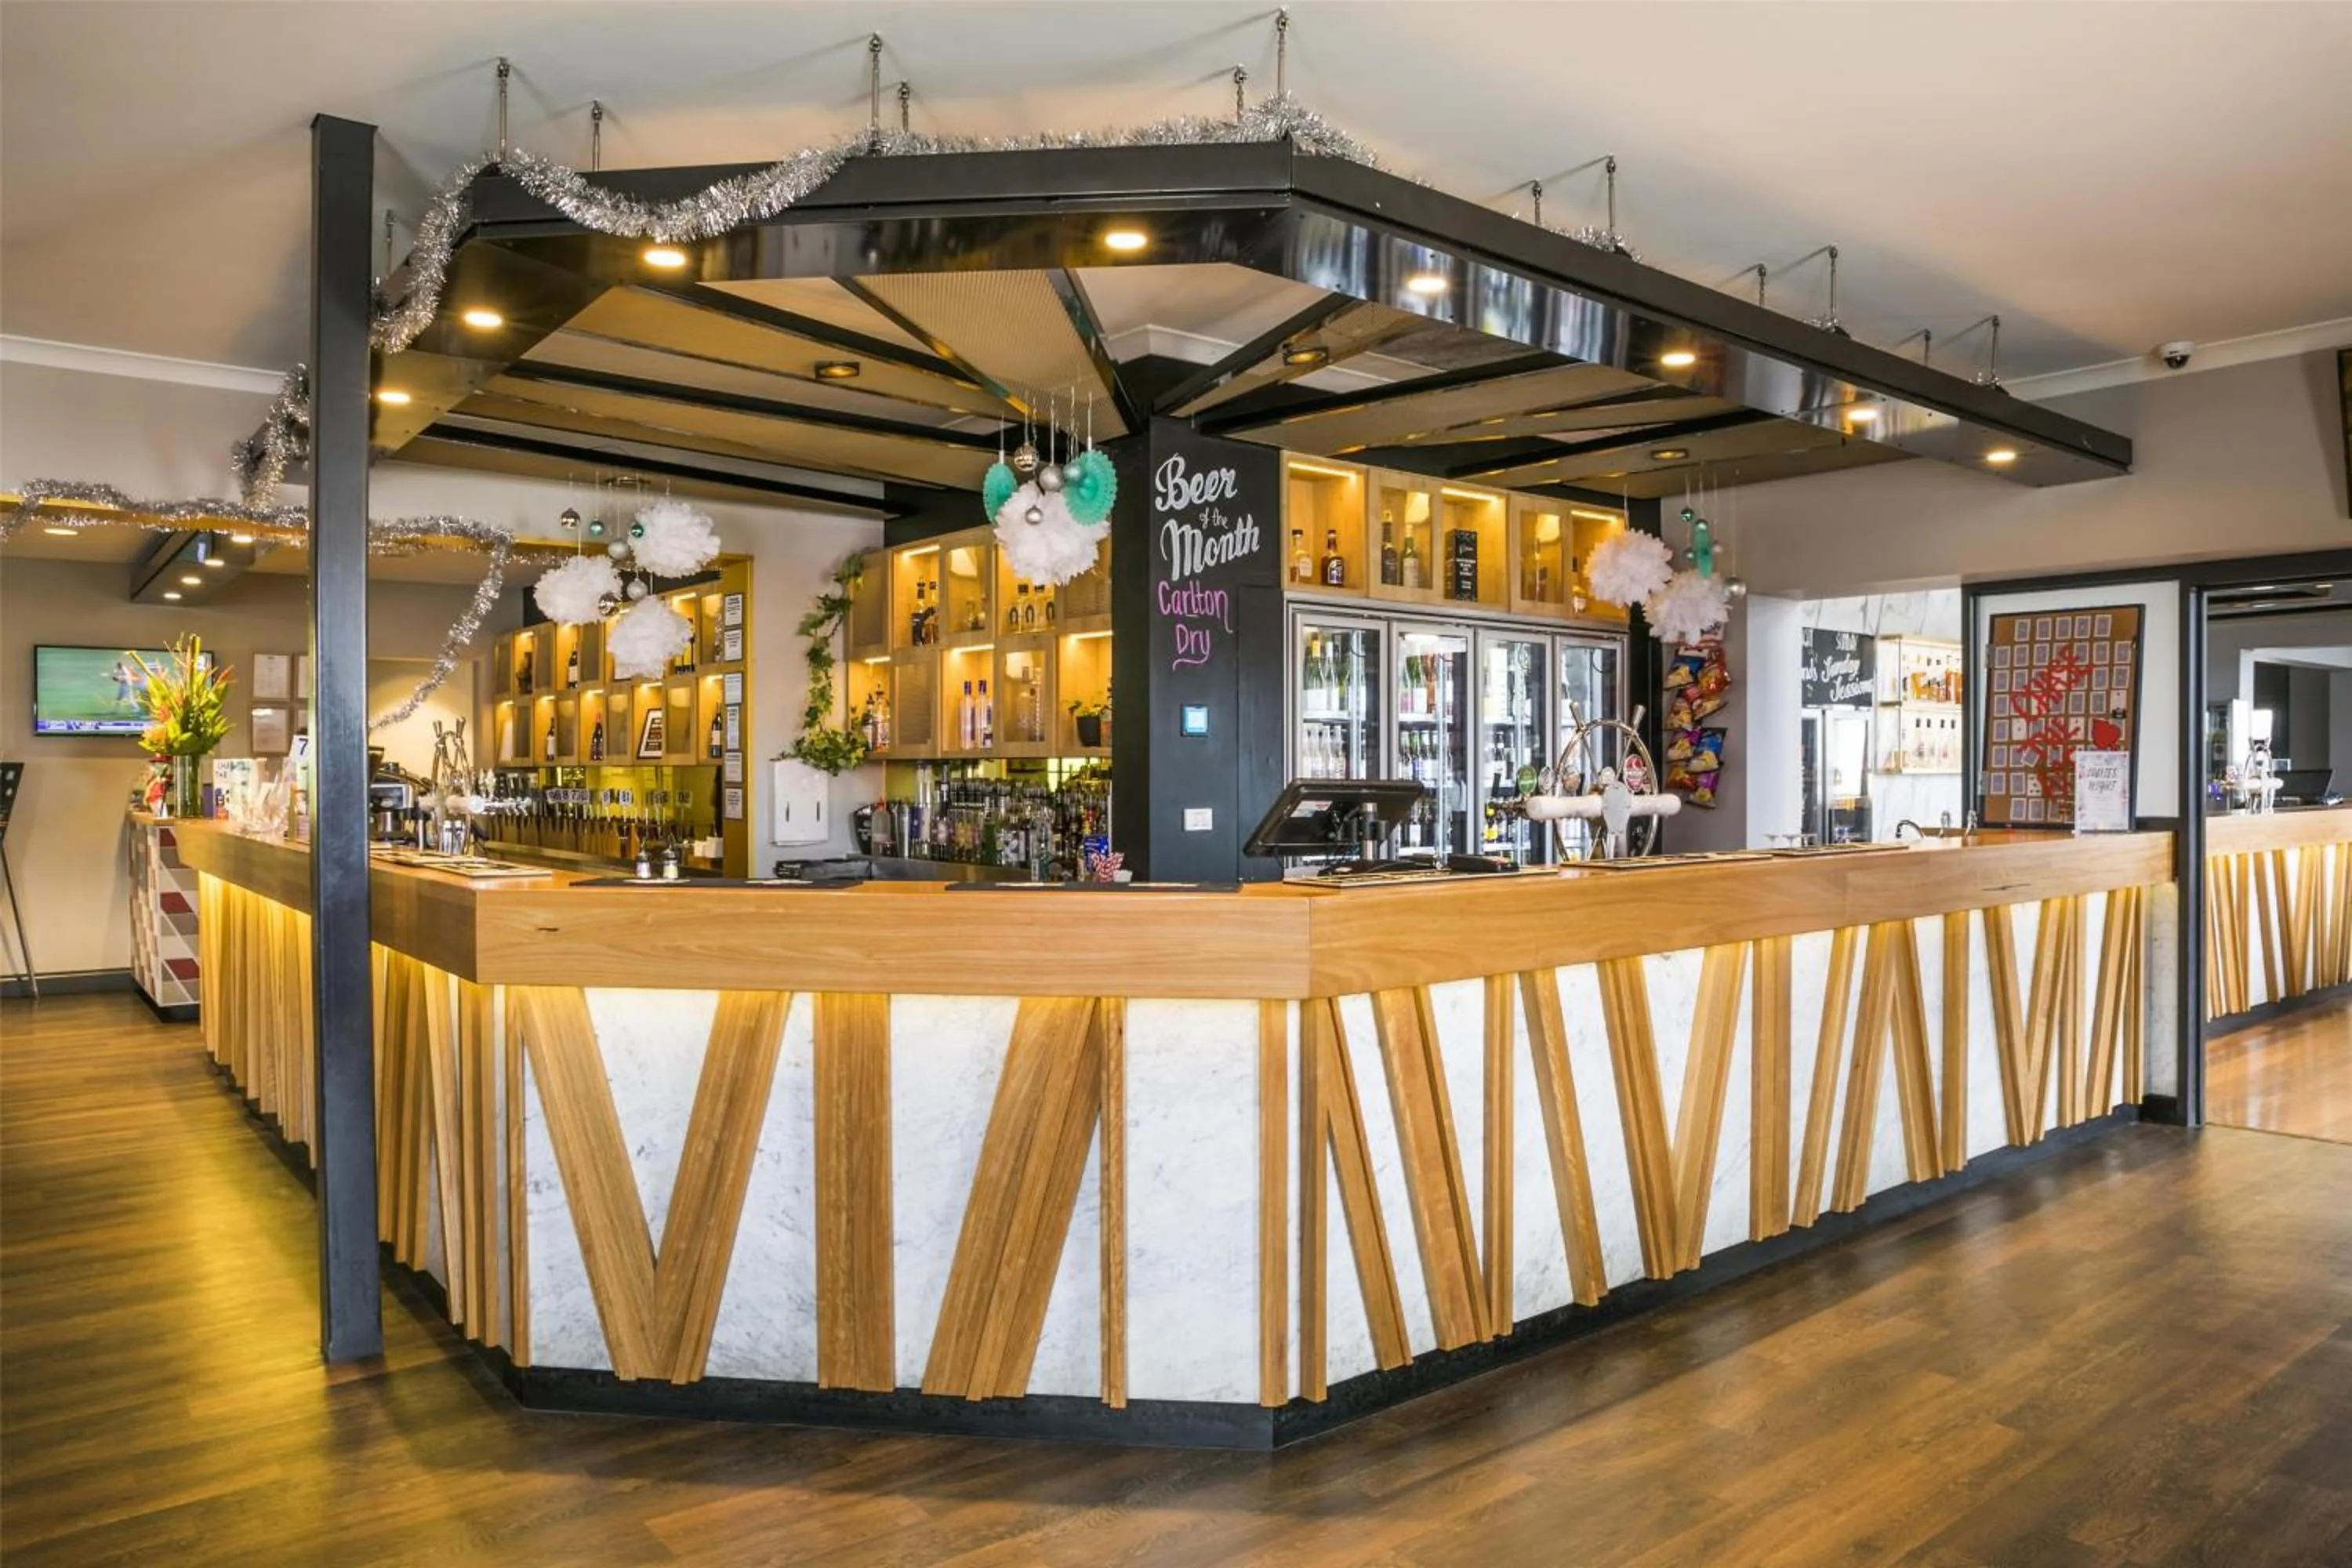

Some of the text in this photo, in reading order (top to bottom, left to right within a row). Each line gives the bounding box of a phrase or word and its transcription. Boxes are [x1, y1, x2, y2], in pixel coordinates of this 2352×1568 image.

[1155, 452, 1238, 511] Beer
[1199, 507, 1229, 529] of the
[1160, 514, 1260, 582] Month
[1158, 579, 1233, 633] Carlton
[1172, 623, 1210, 672] Dry
